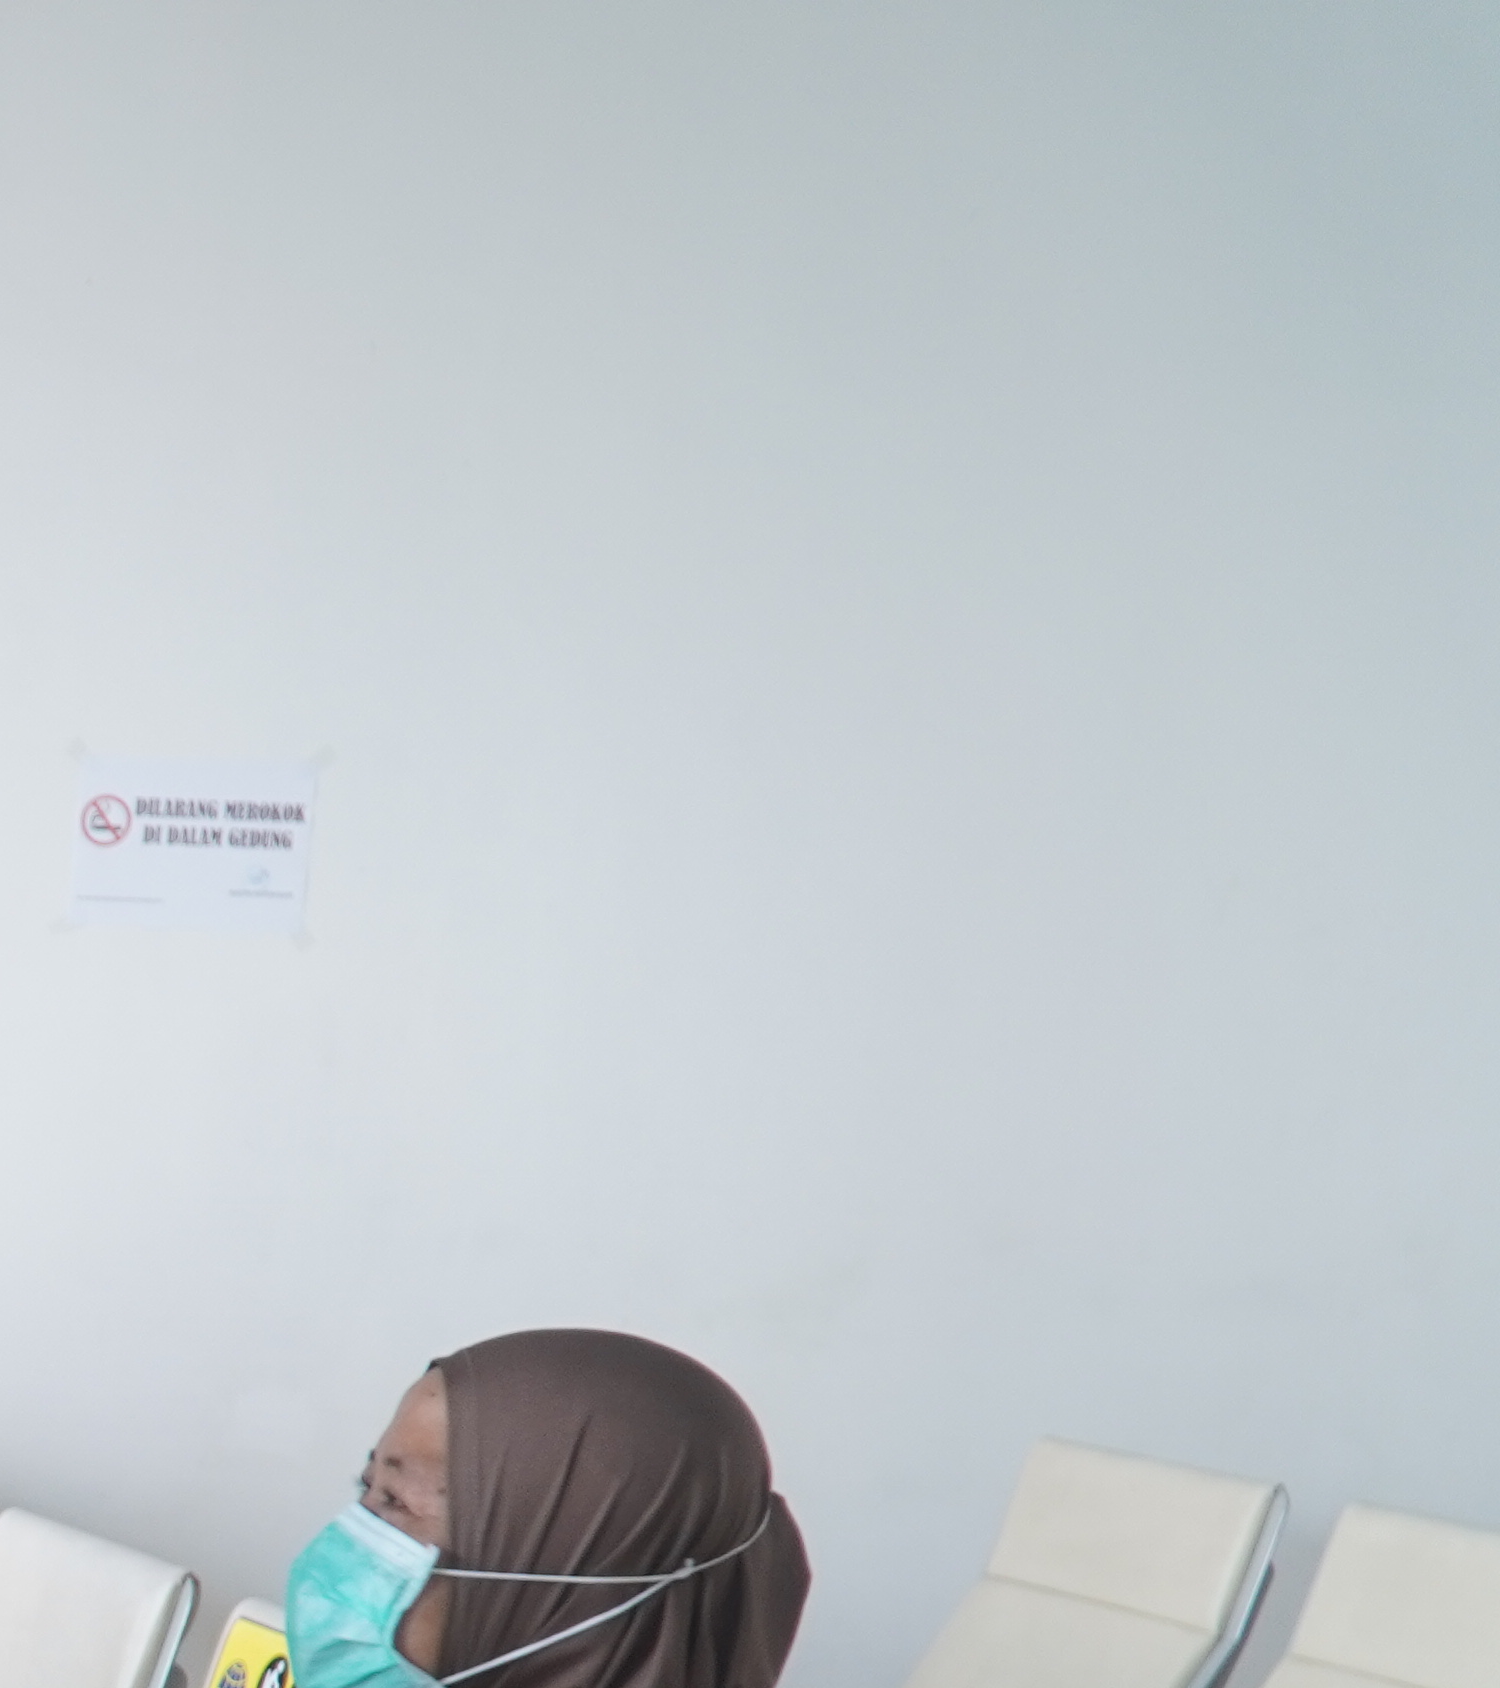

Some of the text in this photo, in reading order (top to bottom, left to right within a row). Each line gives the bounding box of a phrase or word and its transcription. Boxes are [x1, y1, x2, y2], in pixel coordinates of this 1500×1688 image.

[135, 797, 305, 823] DILARANG MEROKOK
[143, 825, 293, 849] DI DALAM GEDUNG
